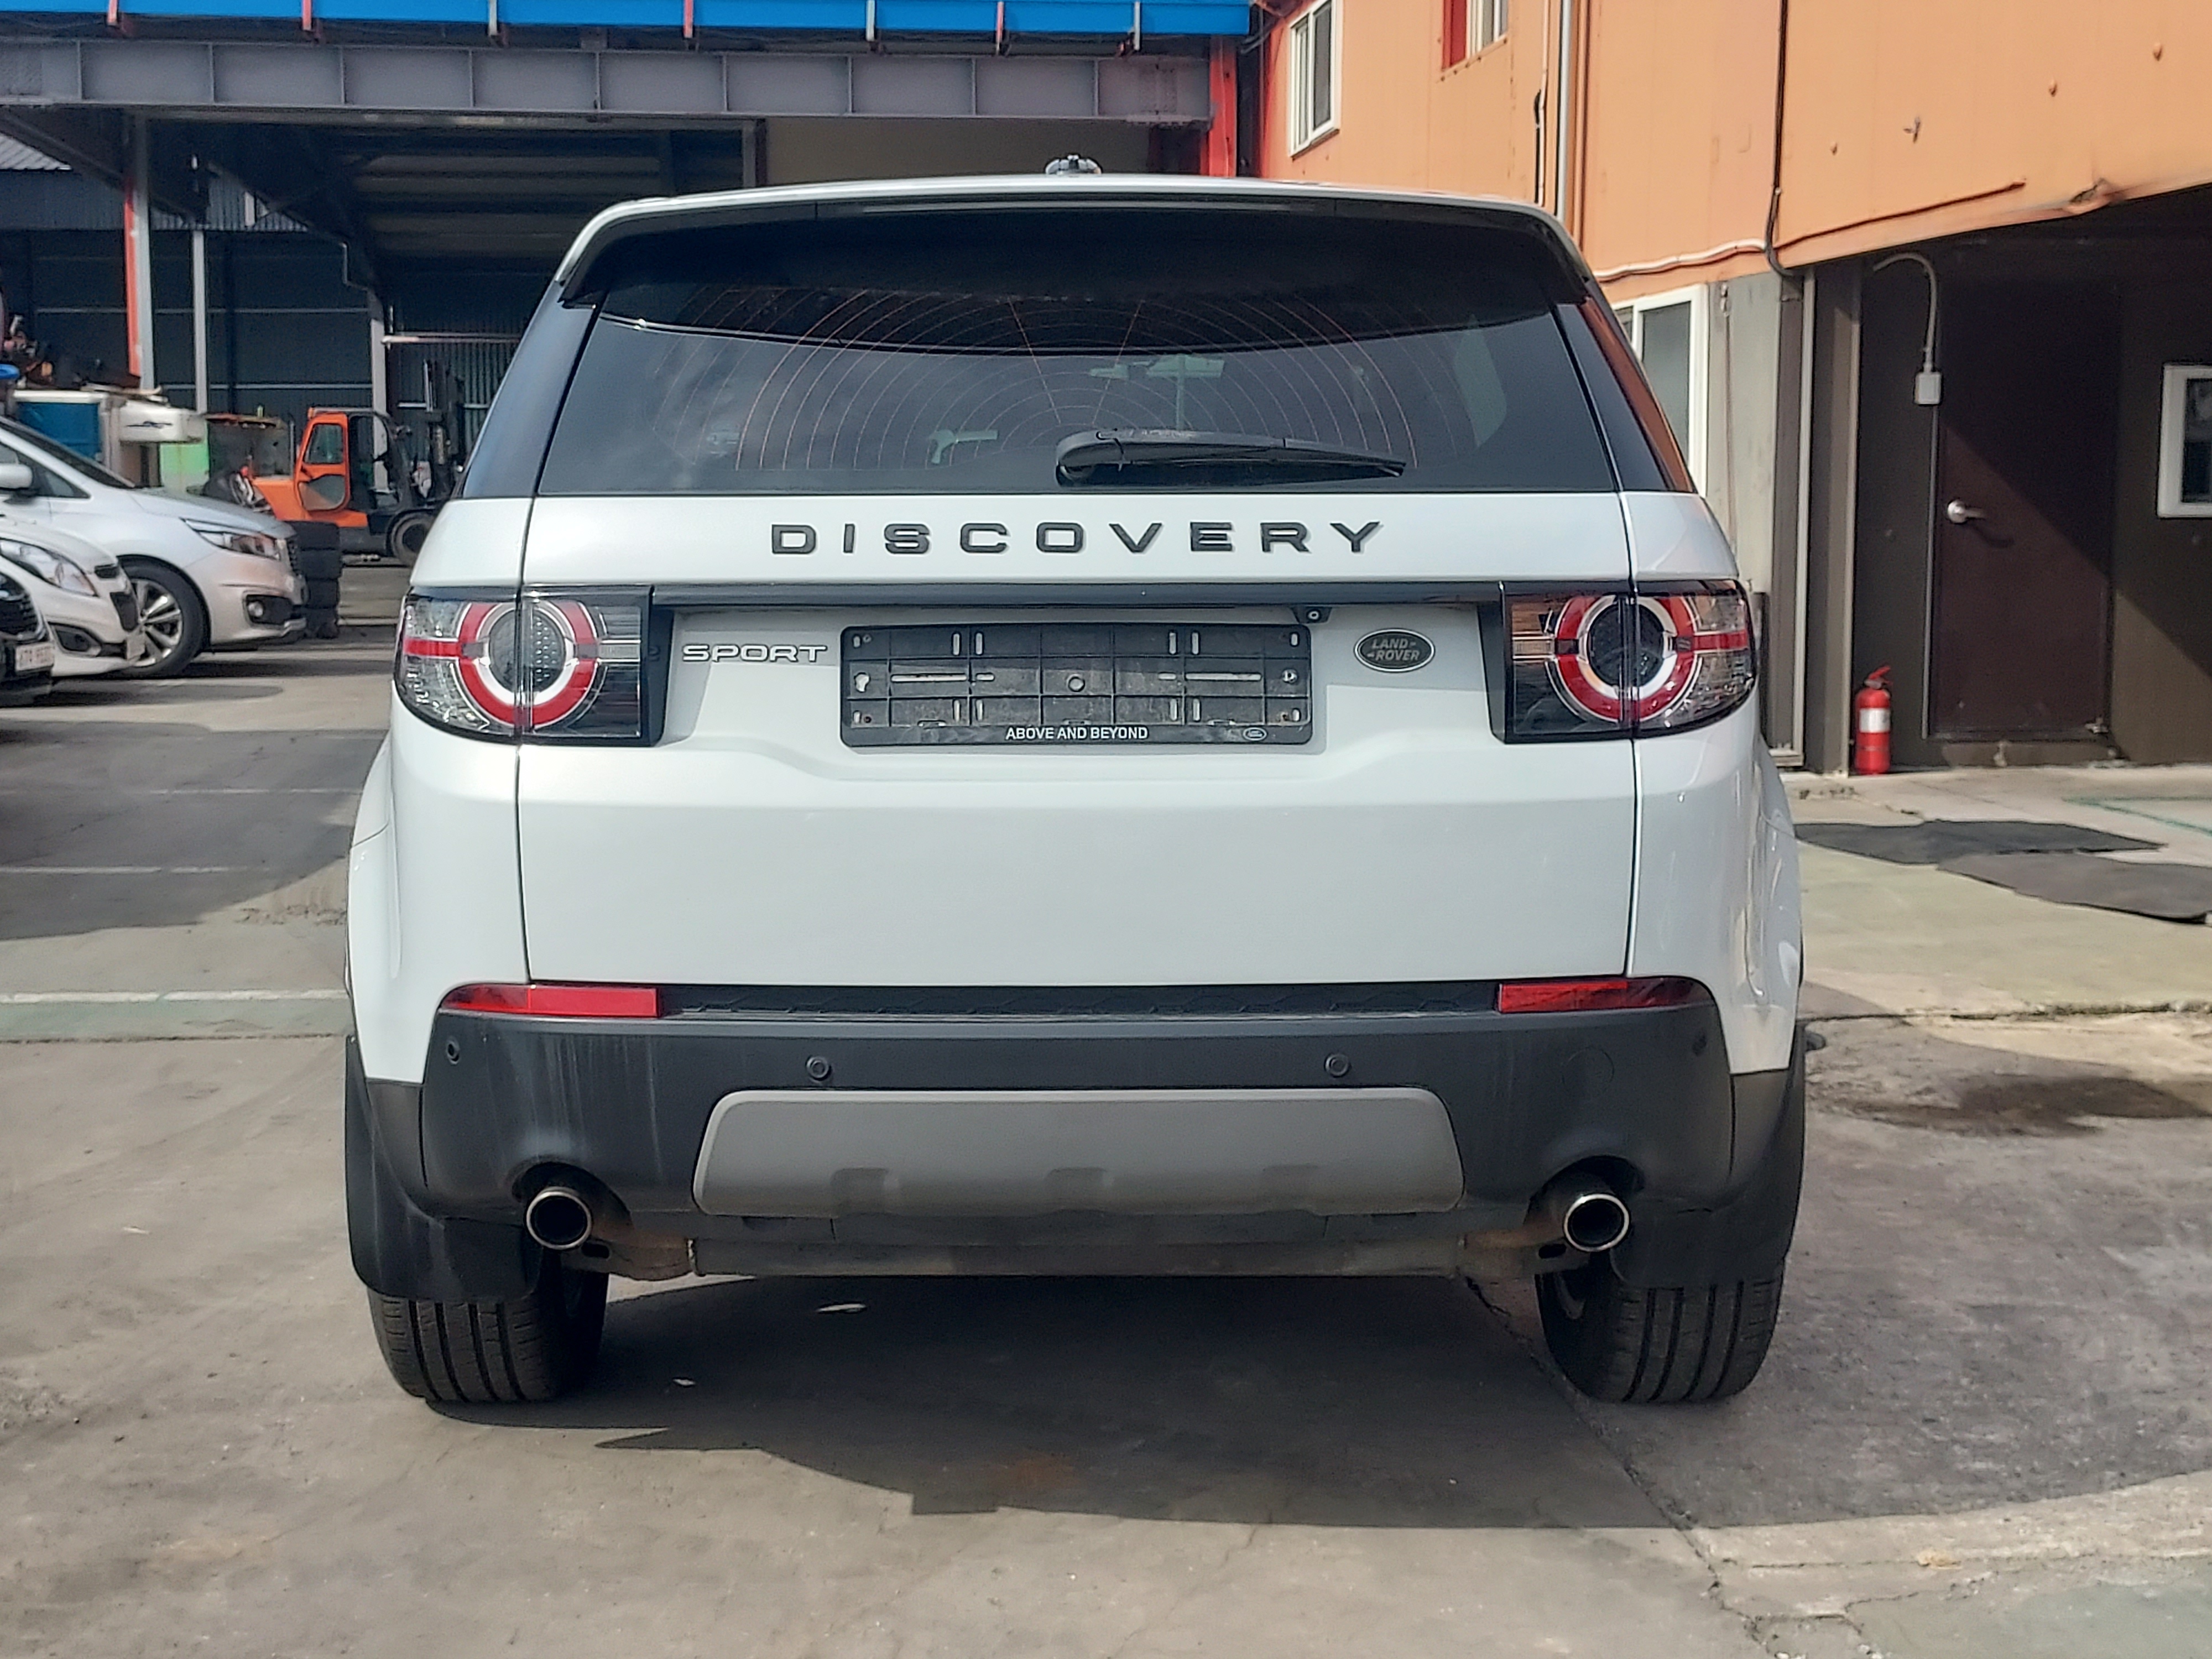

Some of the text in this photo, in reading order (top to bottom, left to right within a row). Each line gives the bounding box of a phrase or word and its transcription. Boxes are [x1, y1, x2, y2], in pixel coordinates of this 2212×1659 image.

[771, 521, 1381, 554] DISCOVERY
[682, 644, 828, 662] SPORT
[1005, 726, 1148, 740] ABOVE AND BEYOND
